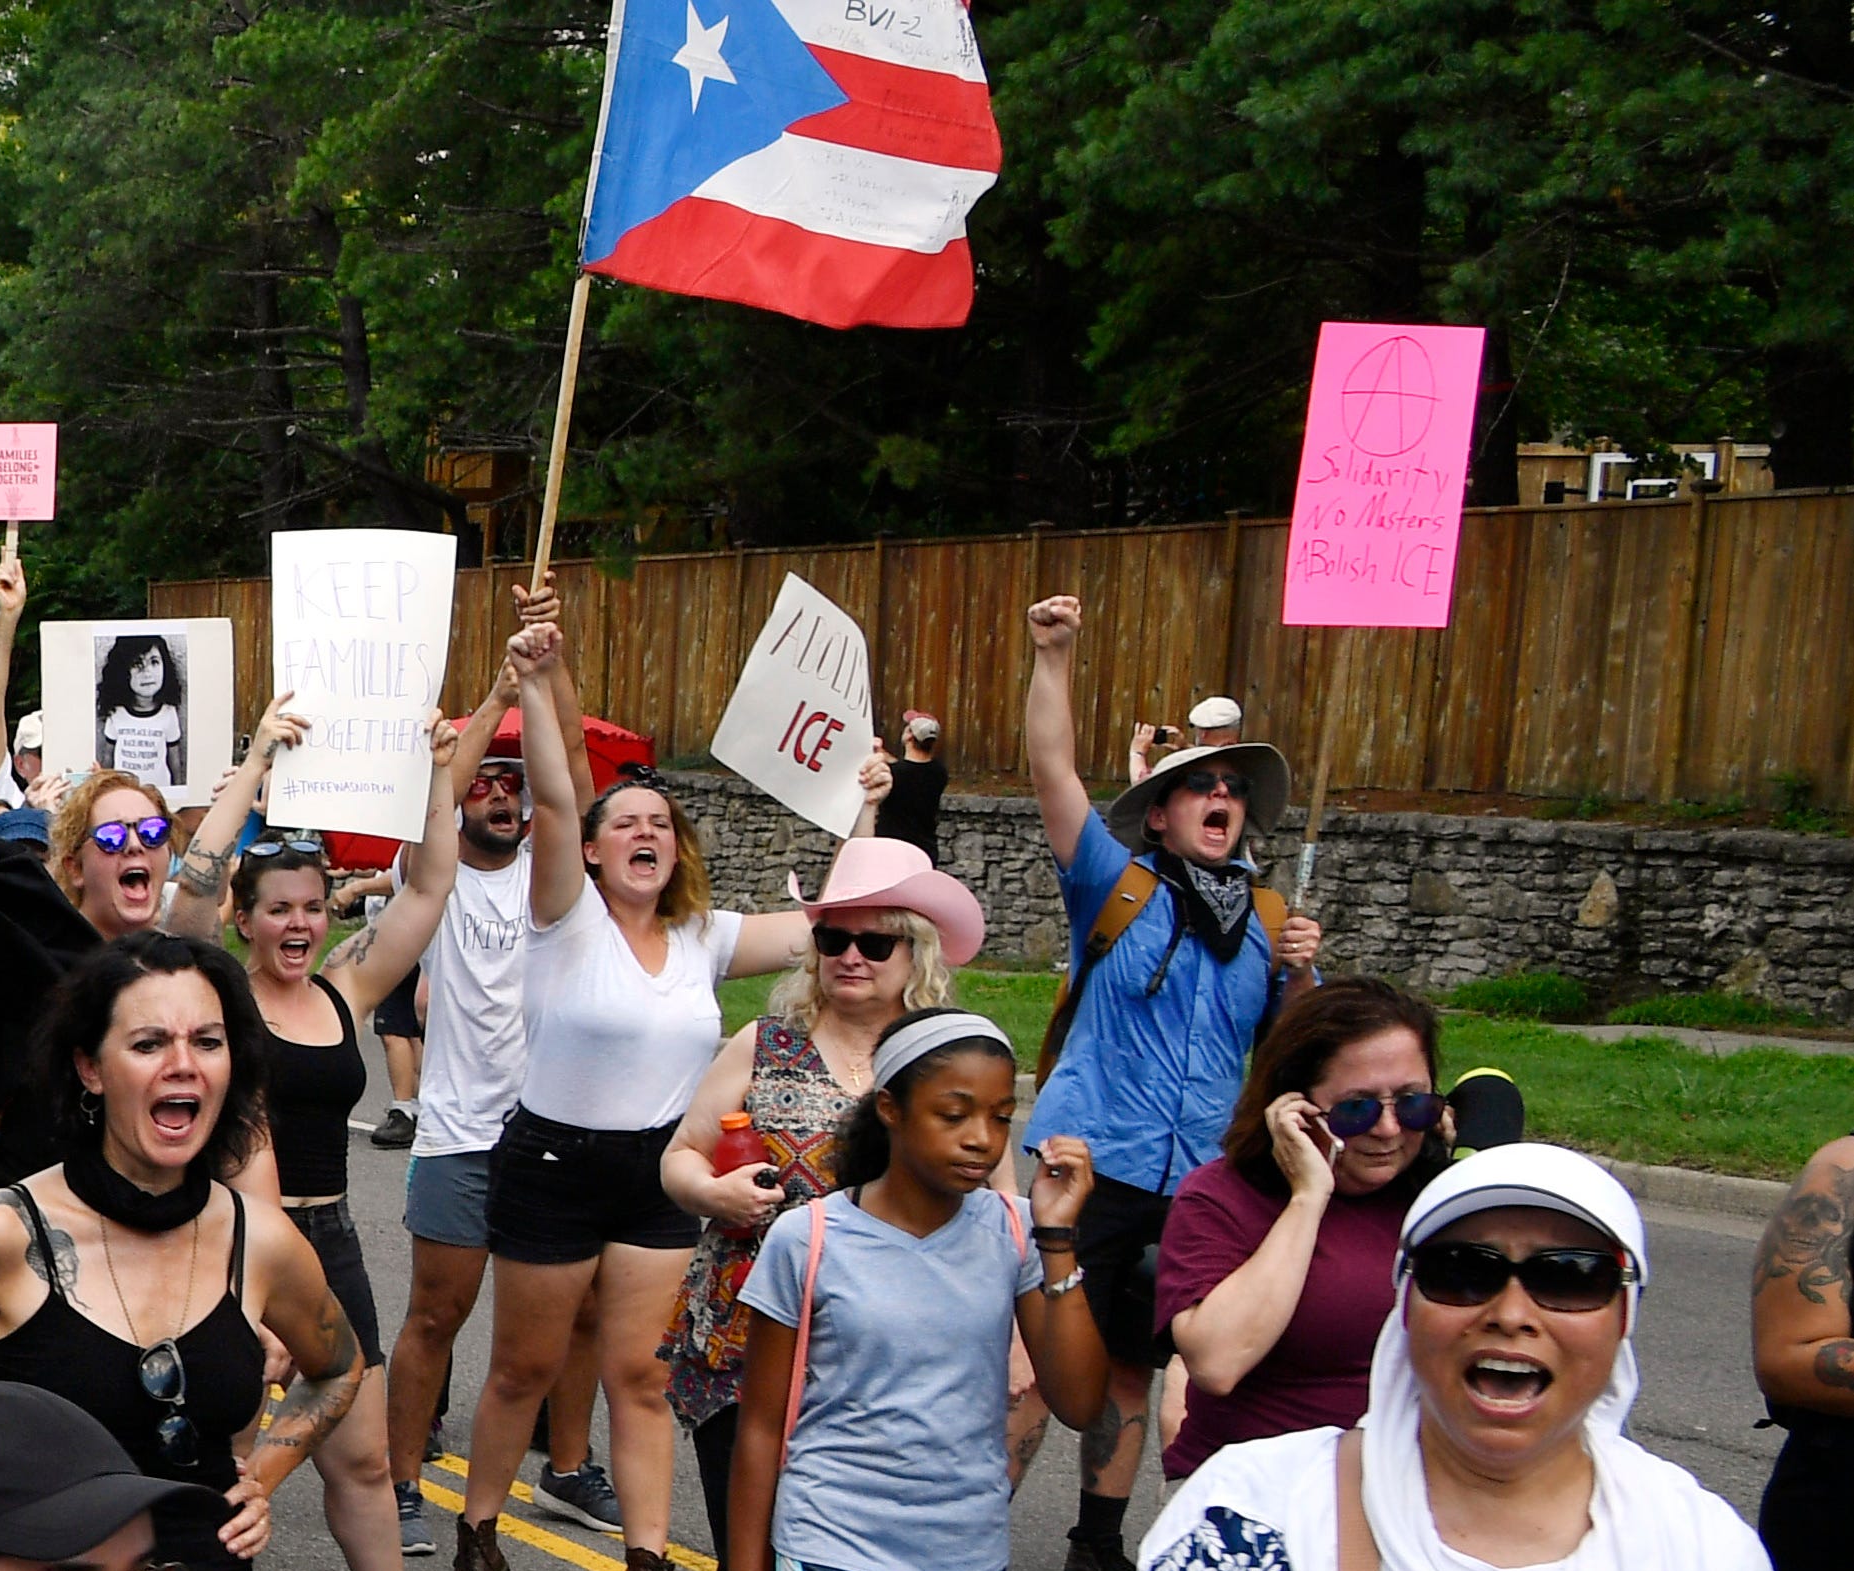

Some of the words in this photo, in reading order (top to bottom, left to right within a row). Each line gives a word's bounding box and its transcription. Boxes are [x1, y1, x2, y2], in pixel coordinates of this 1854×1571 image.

[1306, 445, 1448, 493] Solidarity
[1355, 492, 1445, 533] Masters
[294, 561, 420, 623] KEEP
[1391, 542, 1443, 596] ICE
[284, 638, 433, 707] FAMILIES
[777, 700, 845, 772] ICE
